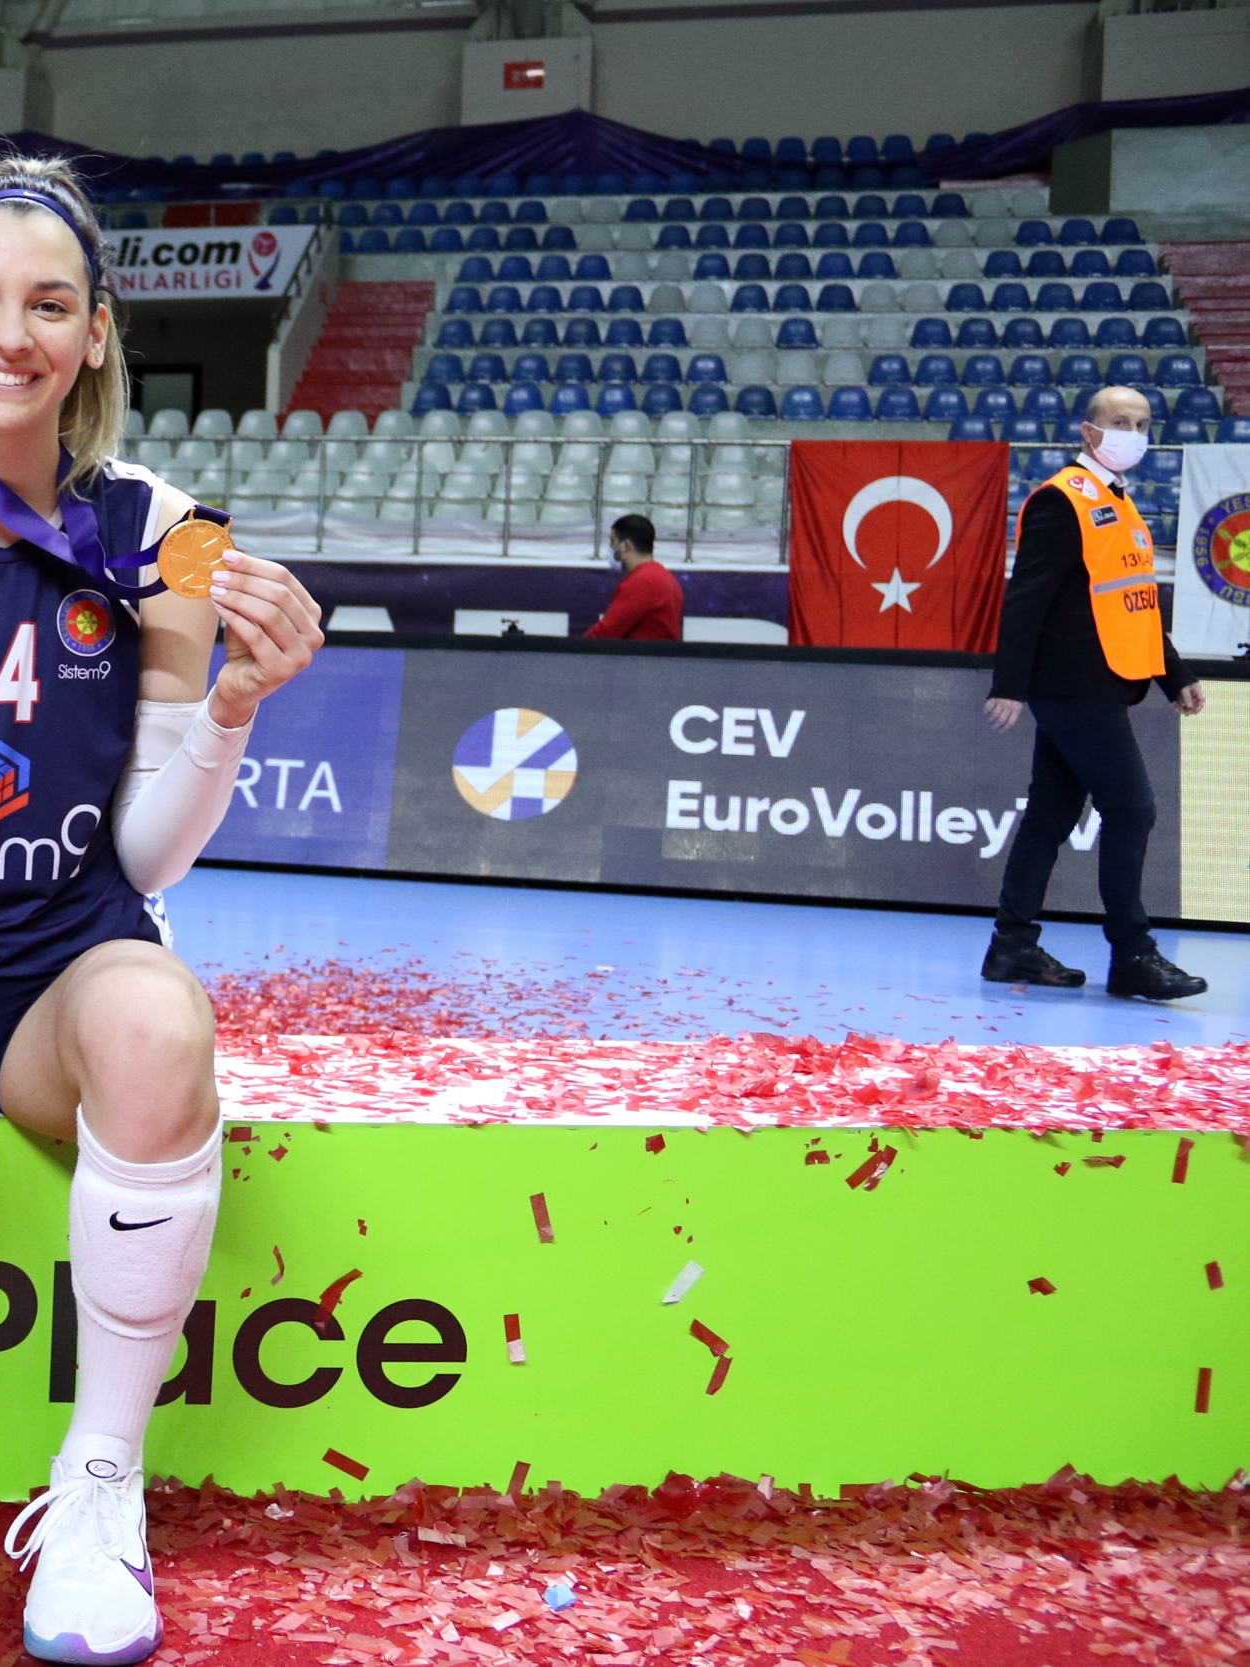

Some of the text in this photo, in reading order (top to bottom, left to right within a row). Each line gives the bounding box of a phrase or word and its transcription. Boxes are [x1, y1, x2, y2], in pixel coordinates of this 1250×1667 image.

[110, 236, 242, 267] li.com
[58, 660, 111, 679] Sistem9
[669, 704, 806, 759] CEV
[234, 756, 343, 814] RTA
[665, 779, 1102, 860] EuroVolleyV
